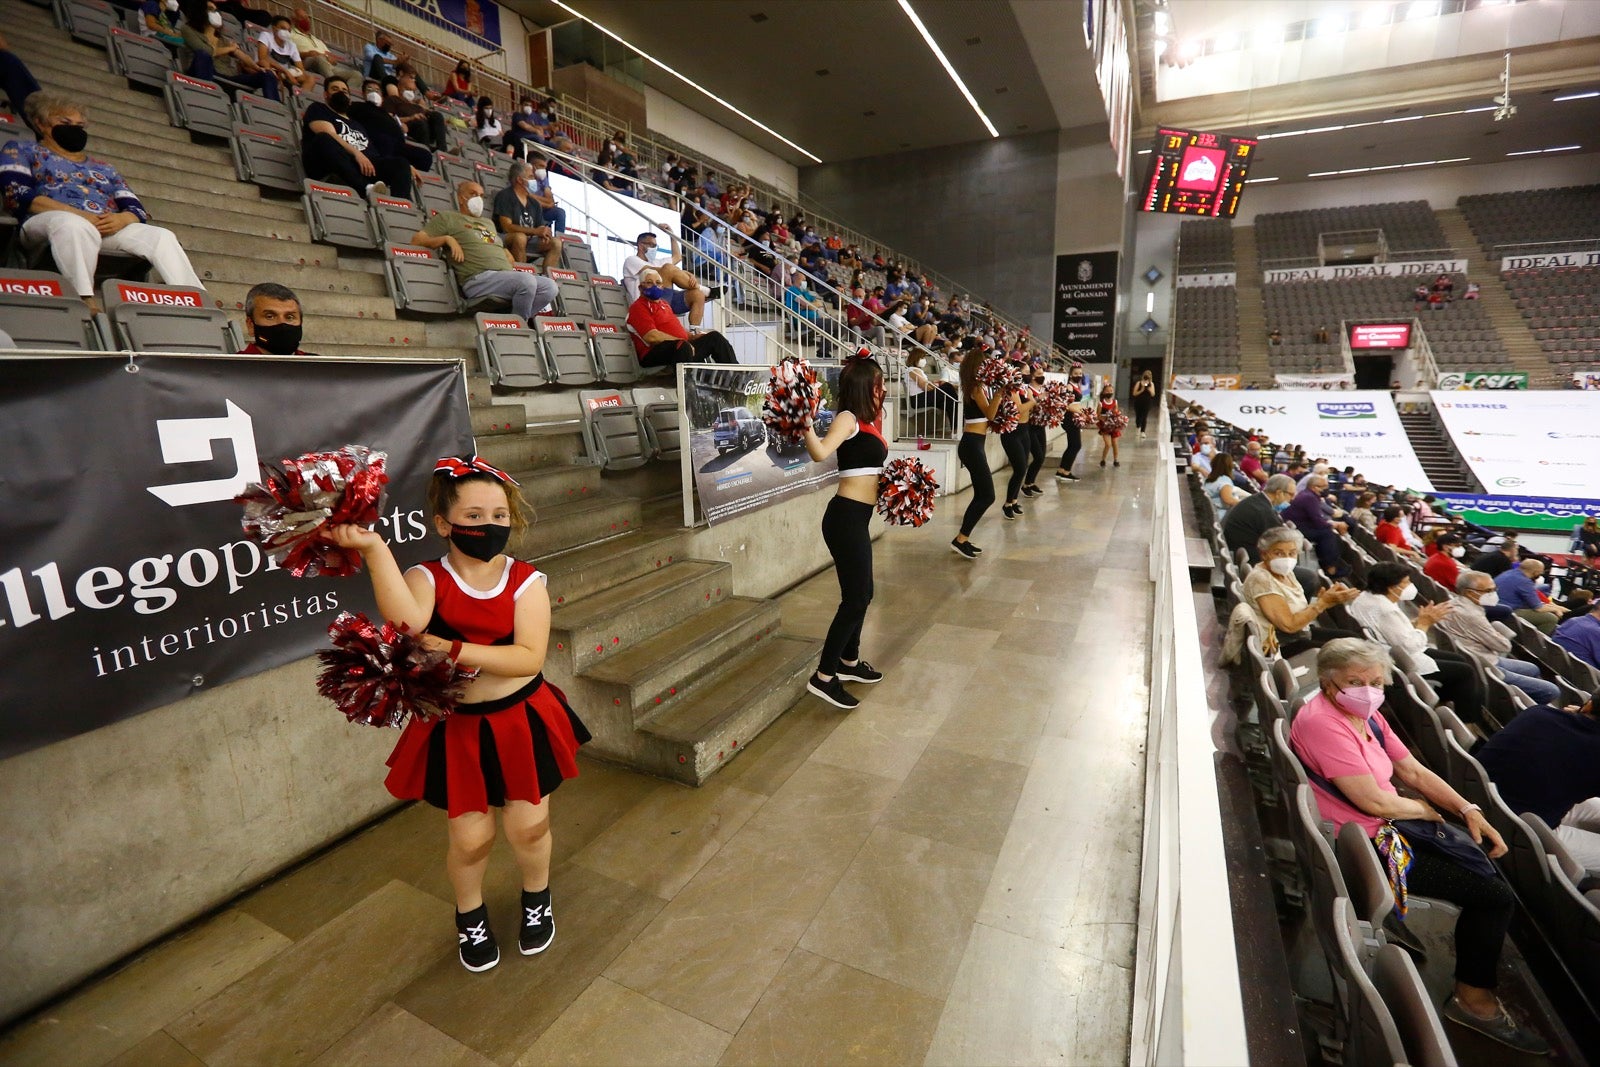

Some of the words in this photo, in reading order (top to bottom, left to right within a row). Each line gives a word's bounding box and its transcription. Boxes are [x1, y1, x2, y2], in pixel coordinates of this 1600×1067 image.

[1508, 255, 1577, 269] IDEAL
[1270, 269, 1324, 282] IDEAL
[1334, 265, 1391, 278] IDEAL
[1400, 262, 1462, 275] IDEAL
[1059, 282, 1114, 291] AYUNTAMIENTO
[124, 289, 149, 303] NO
[151, 293, 196, 307] USAR
[1073, 290, 1108, 298] GRANADA
[1239, 405, 1287, 415] GRX
[1320, 403, 1372, 411] PULEVA
[1477, 499, 1510, 507] PULEVA
[93, 589, 339, 677] interioristas
